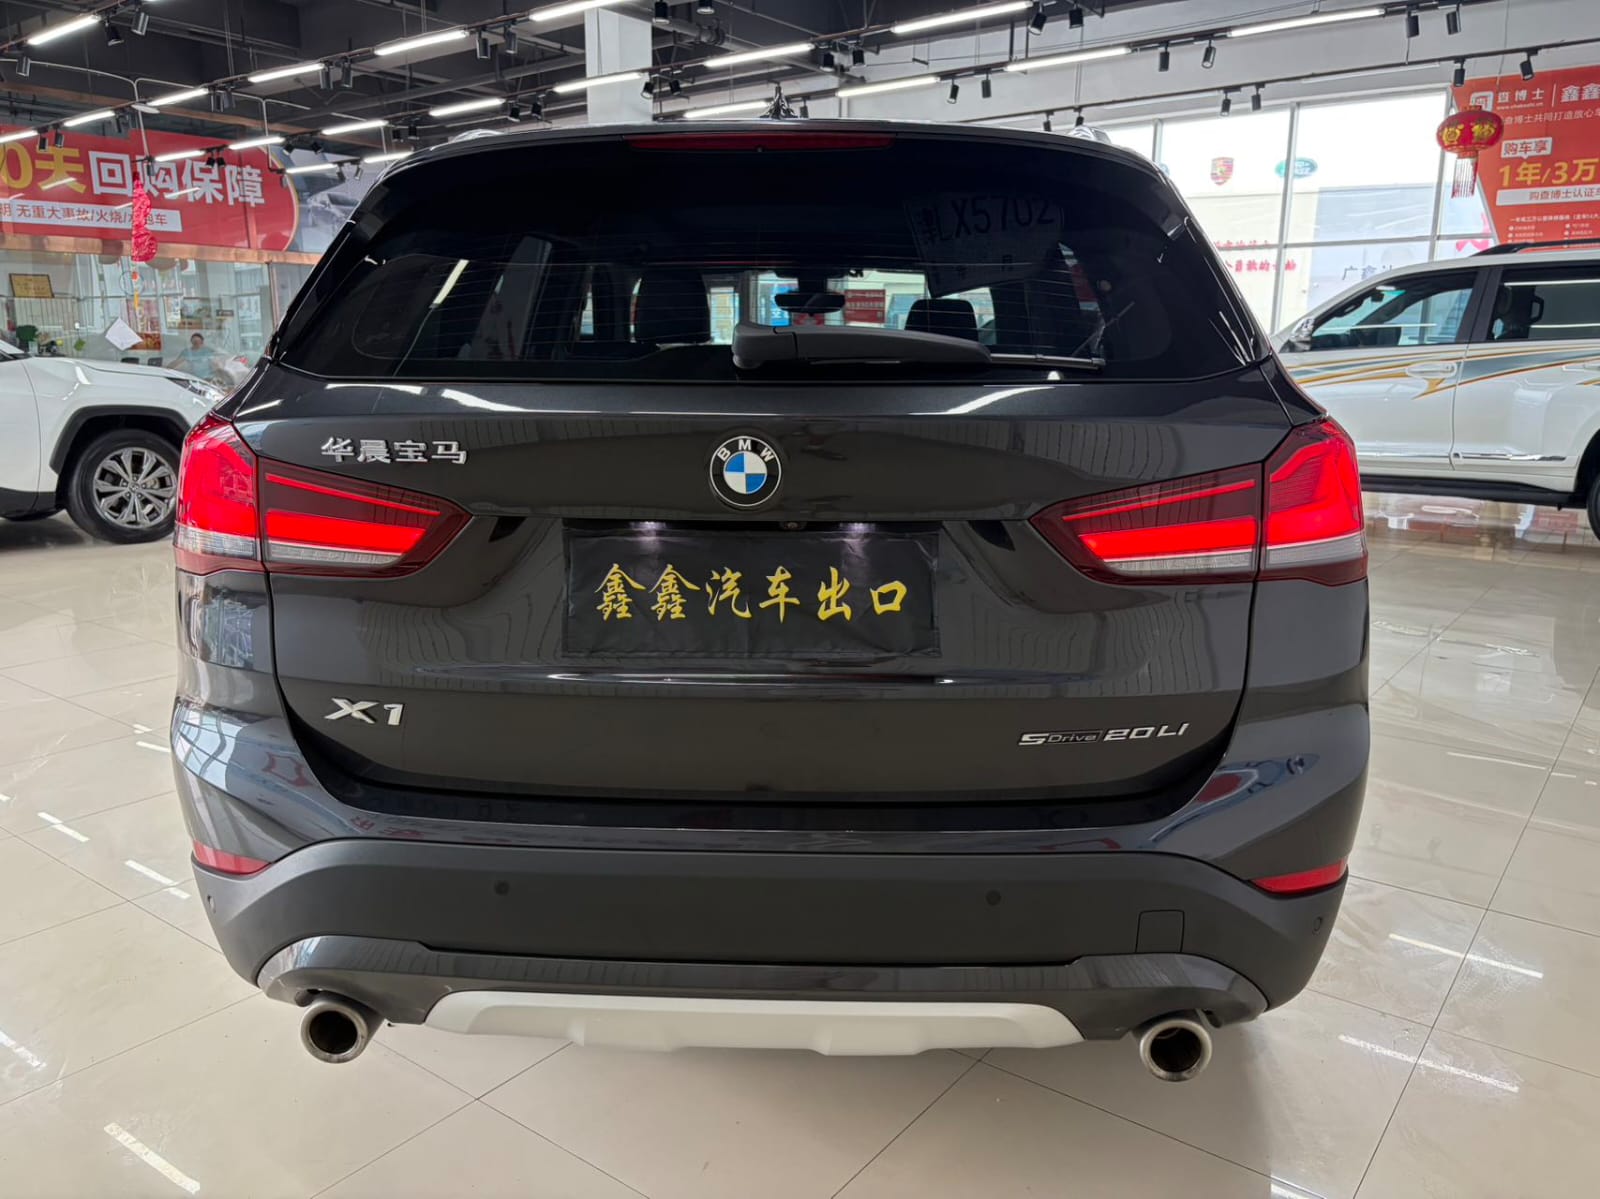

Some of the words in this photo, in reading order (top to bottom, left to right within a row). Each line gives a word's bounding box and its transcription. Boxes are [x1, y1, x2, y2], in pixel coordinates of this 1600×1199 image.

[1497, 87, 1544, 103] 查博士
[1503, 139, 1548, 155] 购车享
[321, 436, 467, 464] 华晨宝马
[717, 439, 774, 462] BMW
[595, 563, 907, 623] 鑫鑫汽车出口
[324, 697, 404, 725] X1
